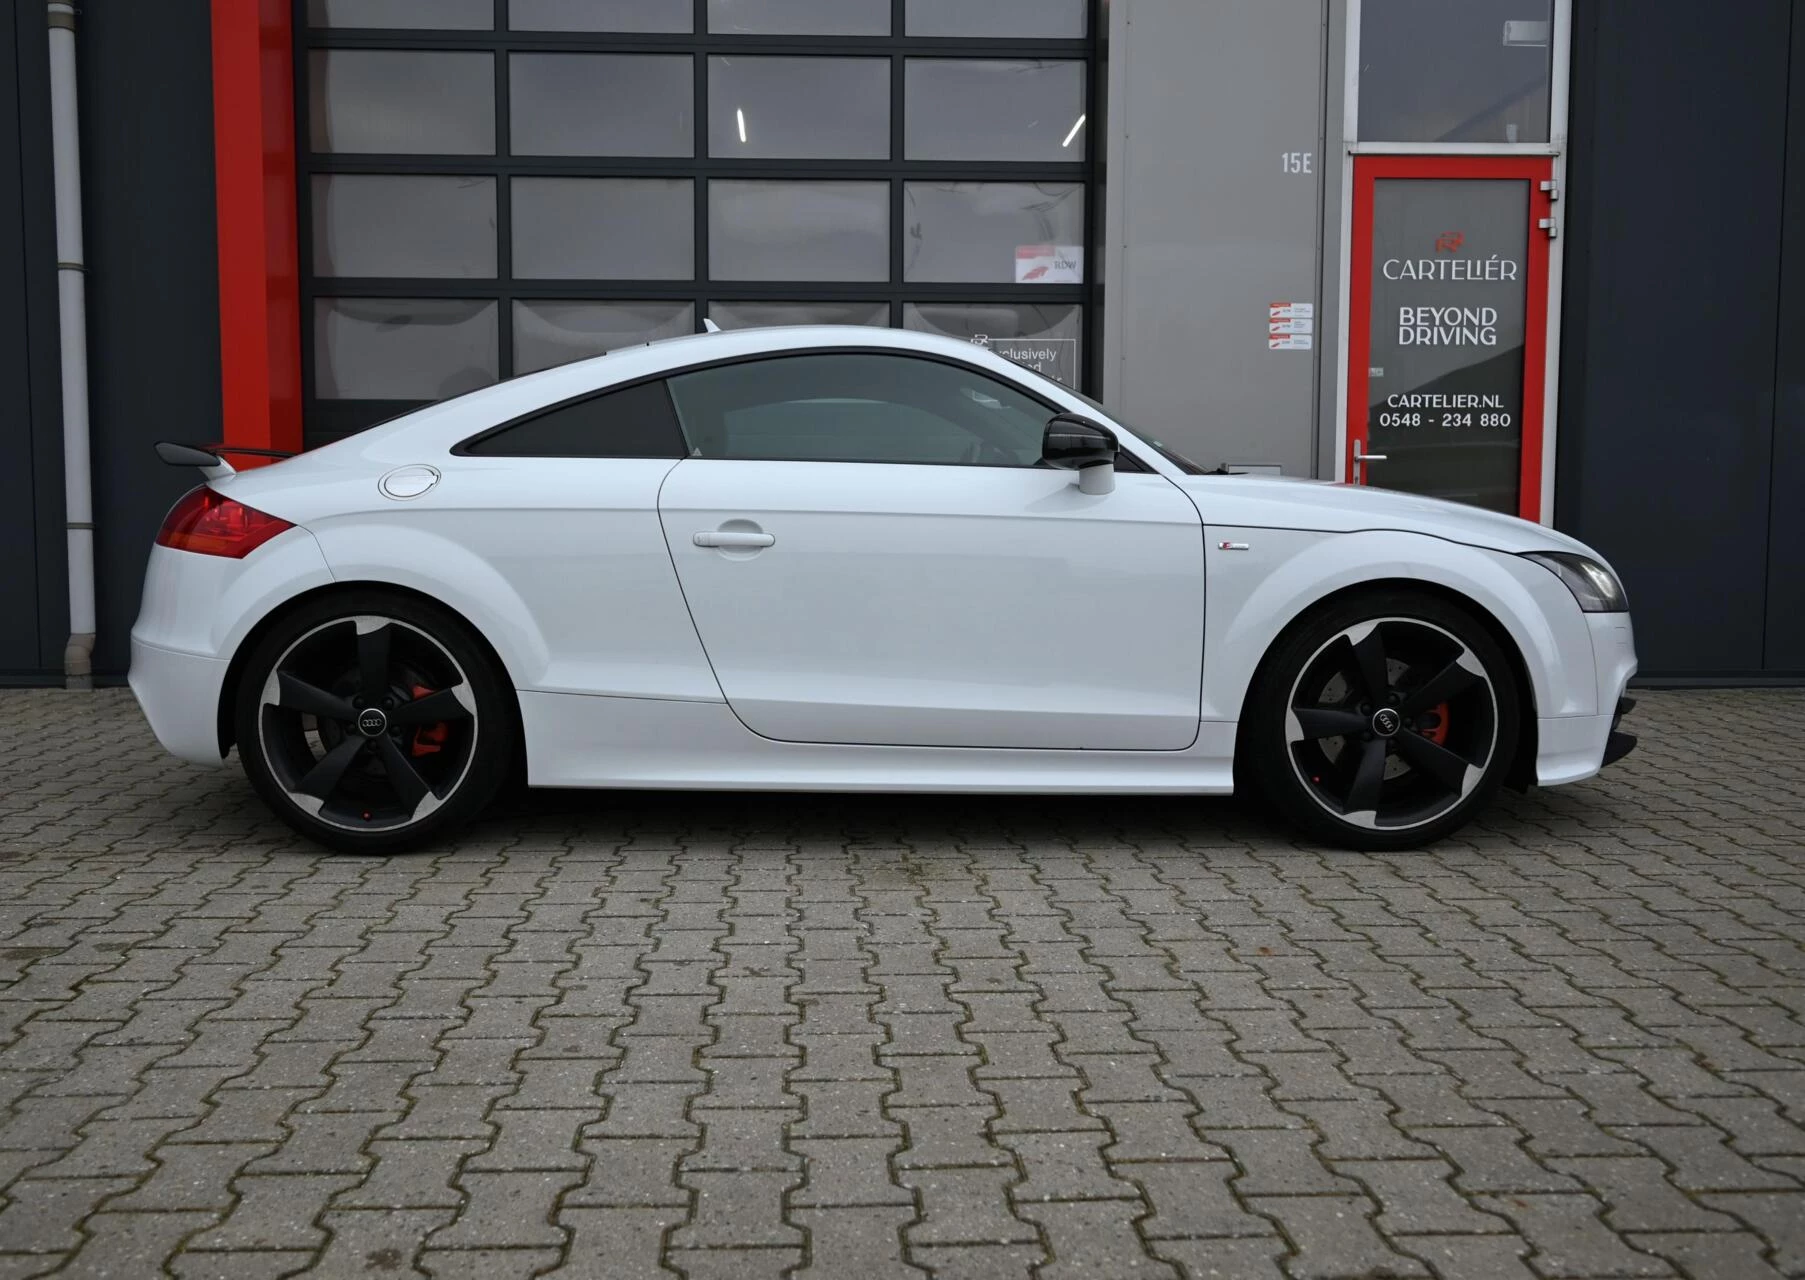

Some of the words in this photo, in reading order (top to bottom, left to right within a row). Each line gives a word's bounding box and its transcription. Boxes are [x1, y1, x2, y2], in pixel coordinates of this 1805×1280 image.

[1282, 152, 1312, 173] 15E
[1383, 254, 1517, 280] CARTELIÉR
[1400, 307, 1497, 326] BEYOND
[1399, 326, 1497, 345] DRIVING
[1000, 348, 1057, 362] lusively
[1387, 394, 1504, 408] CARTELIER.NL
[1380, 413, 1421, 427] 0548
[1442, 413, 1472, 427] 234
[1480, 413, 1511, 427] 880
